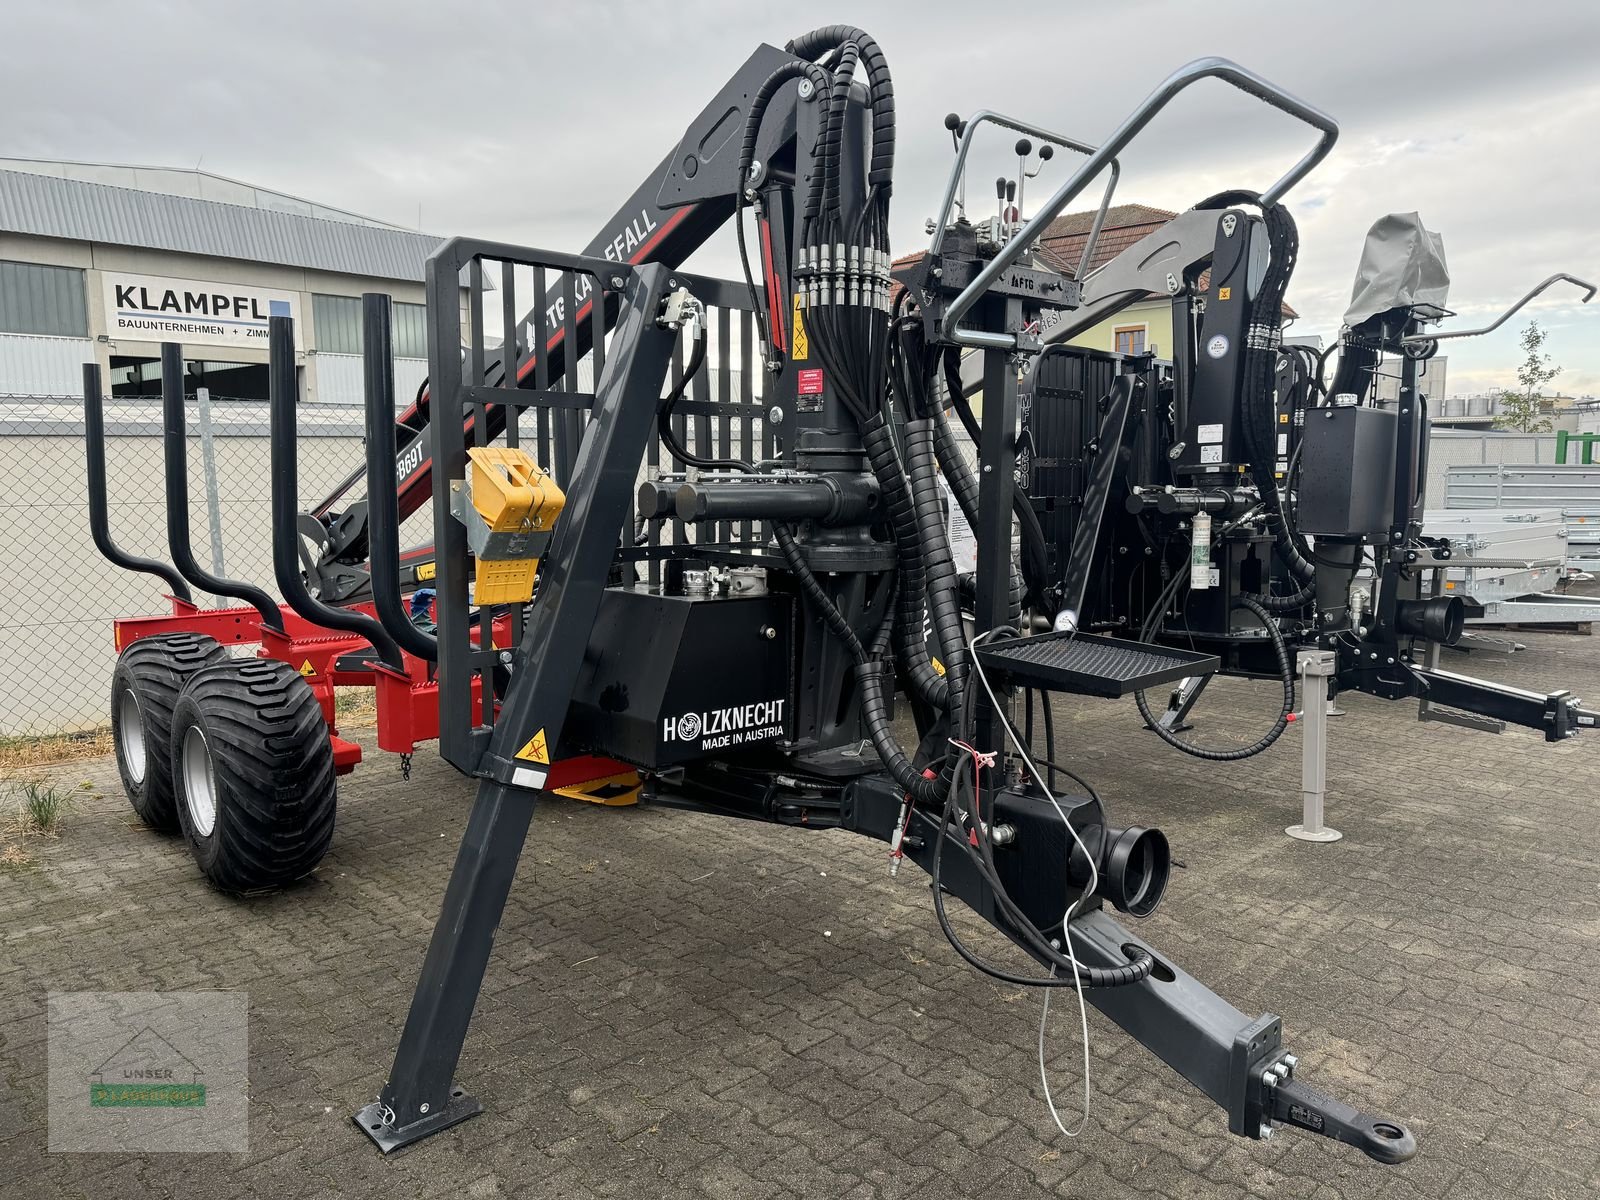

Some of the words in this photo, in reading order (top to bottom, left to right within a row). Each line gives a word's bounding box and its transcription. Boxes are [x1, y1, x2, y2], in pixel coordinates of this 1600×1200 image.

[1019, 277, 1034, 290] FTG
[115, 284, 268, 321] KLAMPFL
[118, 318, 225, 336] BAUUNTERNEHMEN
[232, 328, 239, 336] +
[396, 440, 423, 482] B69T
[663, 699, 785, 742] HOLZKNECHT
[702, 735, 731, 751] MADE
[733, 732, 743, 745] IN
[744, 725, 784, 742] AUSTRIA
